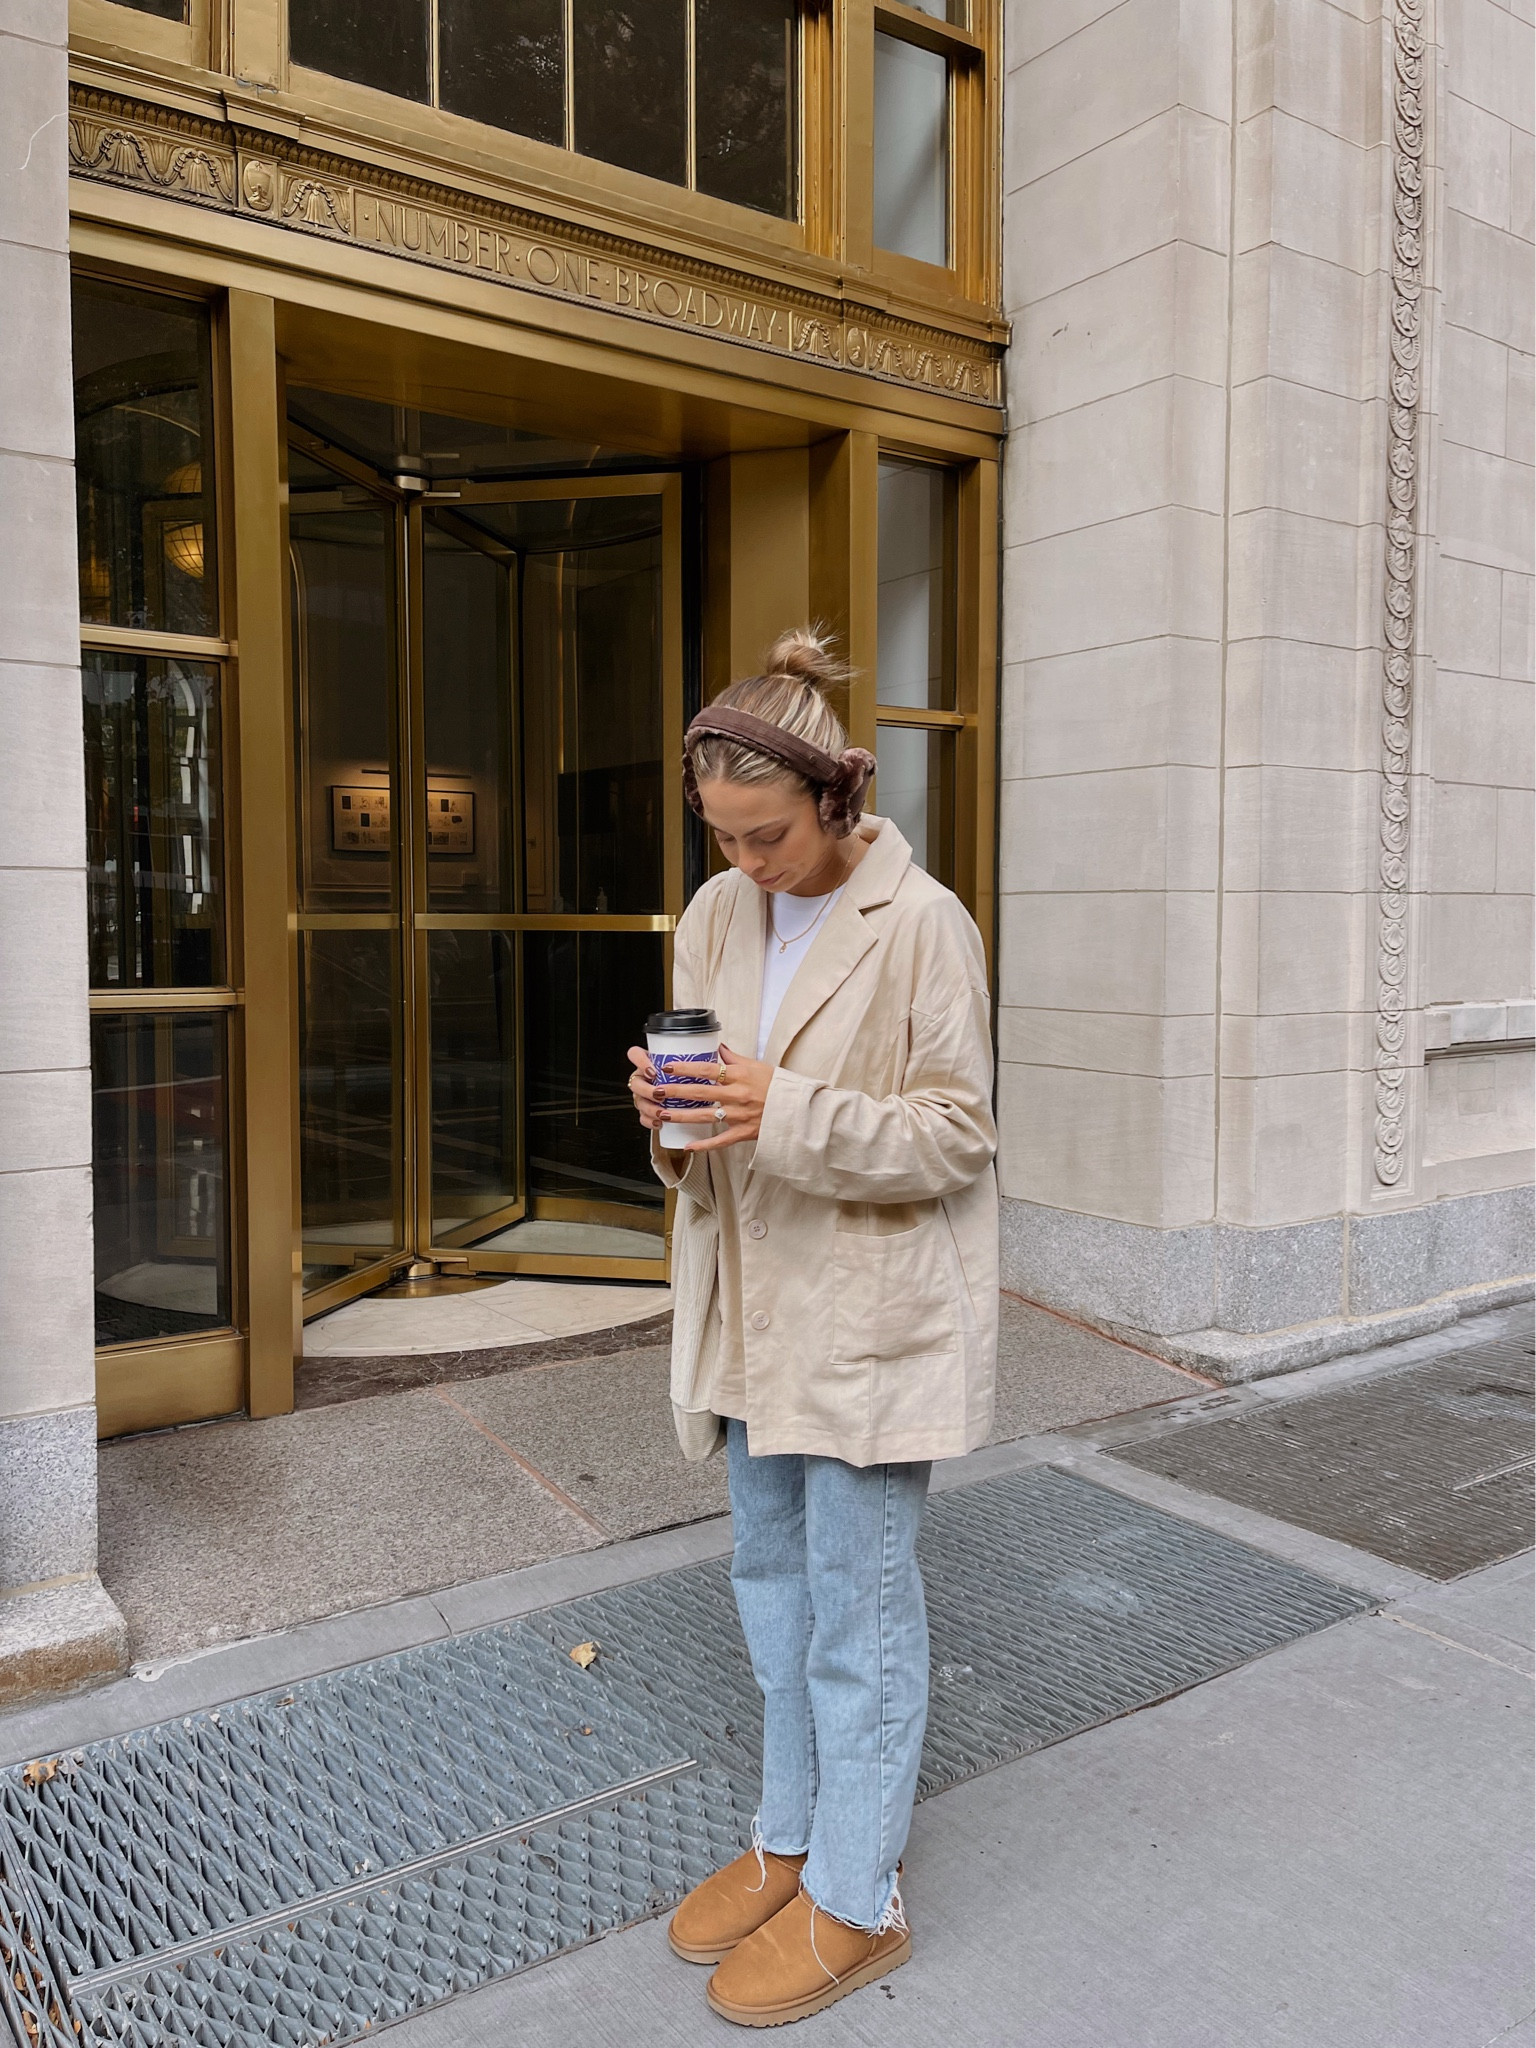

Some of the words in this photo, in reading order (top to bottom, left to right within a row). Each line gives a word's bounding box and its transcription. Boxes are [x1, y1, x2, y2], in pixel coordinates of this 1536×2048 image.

[375, 200, 514, 276] NUMBER
[526, 244, 602, 300] ONE
[615, 266, 777, 344] BROADWAY
